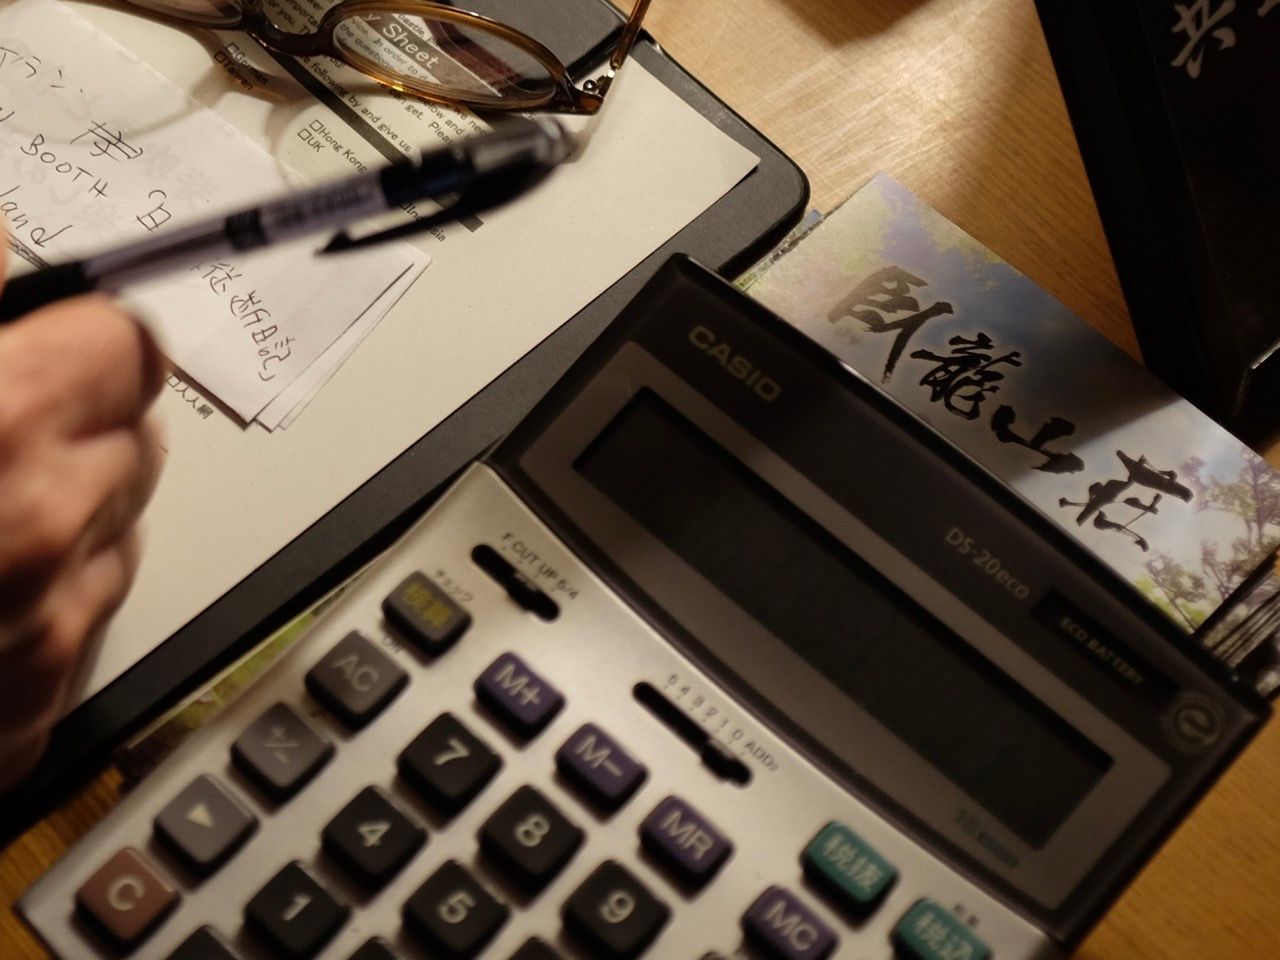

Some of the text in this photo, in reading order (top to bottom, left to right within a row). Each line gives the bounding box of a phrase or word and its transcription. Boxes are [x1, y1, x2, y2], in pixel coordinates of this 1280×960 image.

[380, 18, 441, 73] Sheet
[307, 60, 413, 154] following by and give us
[305, 134, 325, 154] UK
[315, 125, 346, 154] Hong
[20, 133, 110, 200] BOOTH
[688, 324, 784, 403] CASIO
[943, 527, 1031, 600] DS-20eco
[332, 654, 381, 693] AC
[494, 662, 543, 708] M+
[433, 740, 471, 766] 7
[357, 820, 391, 848] 4
[513, 812, 552, 849] 8
[658, 808, 713, 863] MR
[107, 878, 146, 911] C
[281, 893, 314, 922] 1
[437, 892, 478, 924] 5
[599, 891, 637, 925] 9
[764, 901, 821, 952] MC
